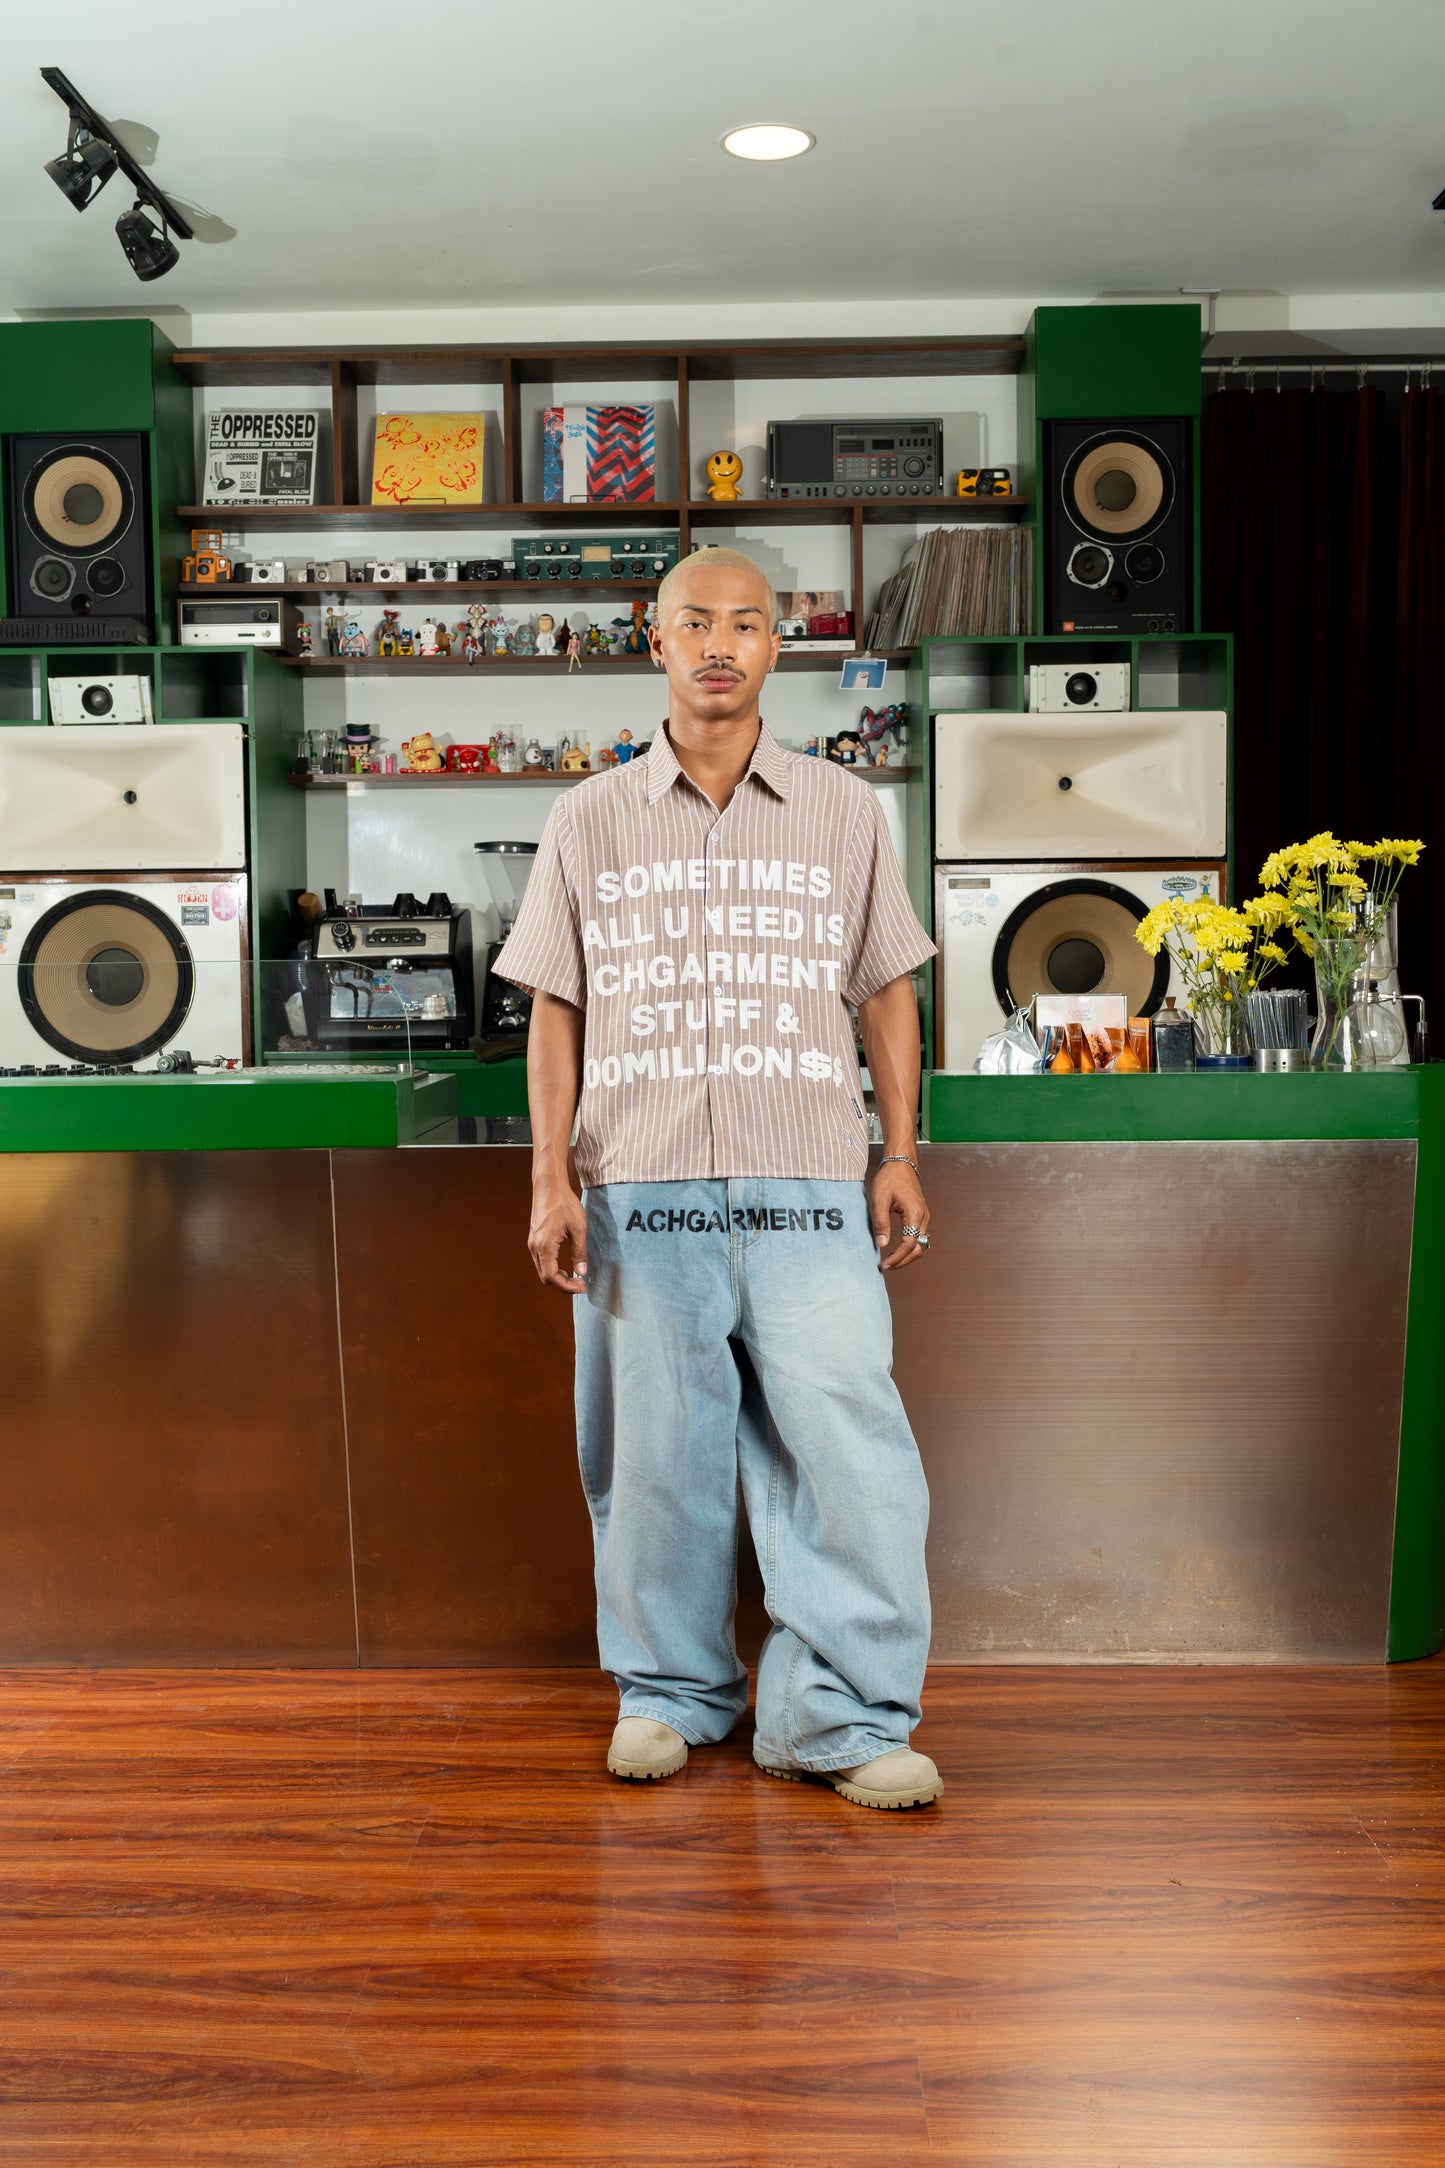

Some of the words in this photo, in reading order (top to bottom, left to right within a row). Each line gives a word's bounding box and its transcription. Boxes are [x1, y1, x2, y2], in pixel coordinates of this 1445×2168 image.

[210, 415, 220, 439] THE
[221, 414, 316, 439] OPPRESSED
[230, 452, 259, 461] OPPRESSED
[597, 859, 832, 903] SOMETIMES
[584, 913, 654, 951] ALL
[664, 906, 689, 938] U
[702, 905, 804, 941] NEED
[814, 913, 845, 946] IS
[587, 951, 841, 997] CHGARMENT
[631, 998, 762, 1036] STUFF
[775, 1002, 801, 1034] &
[625, 1208, 844, 1233] ACHGARMENTS
